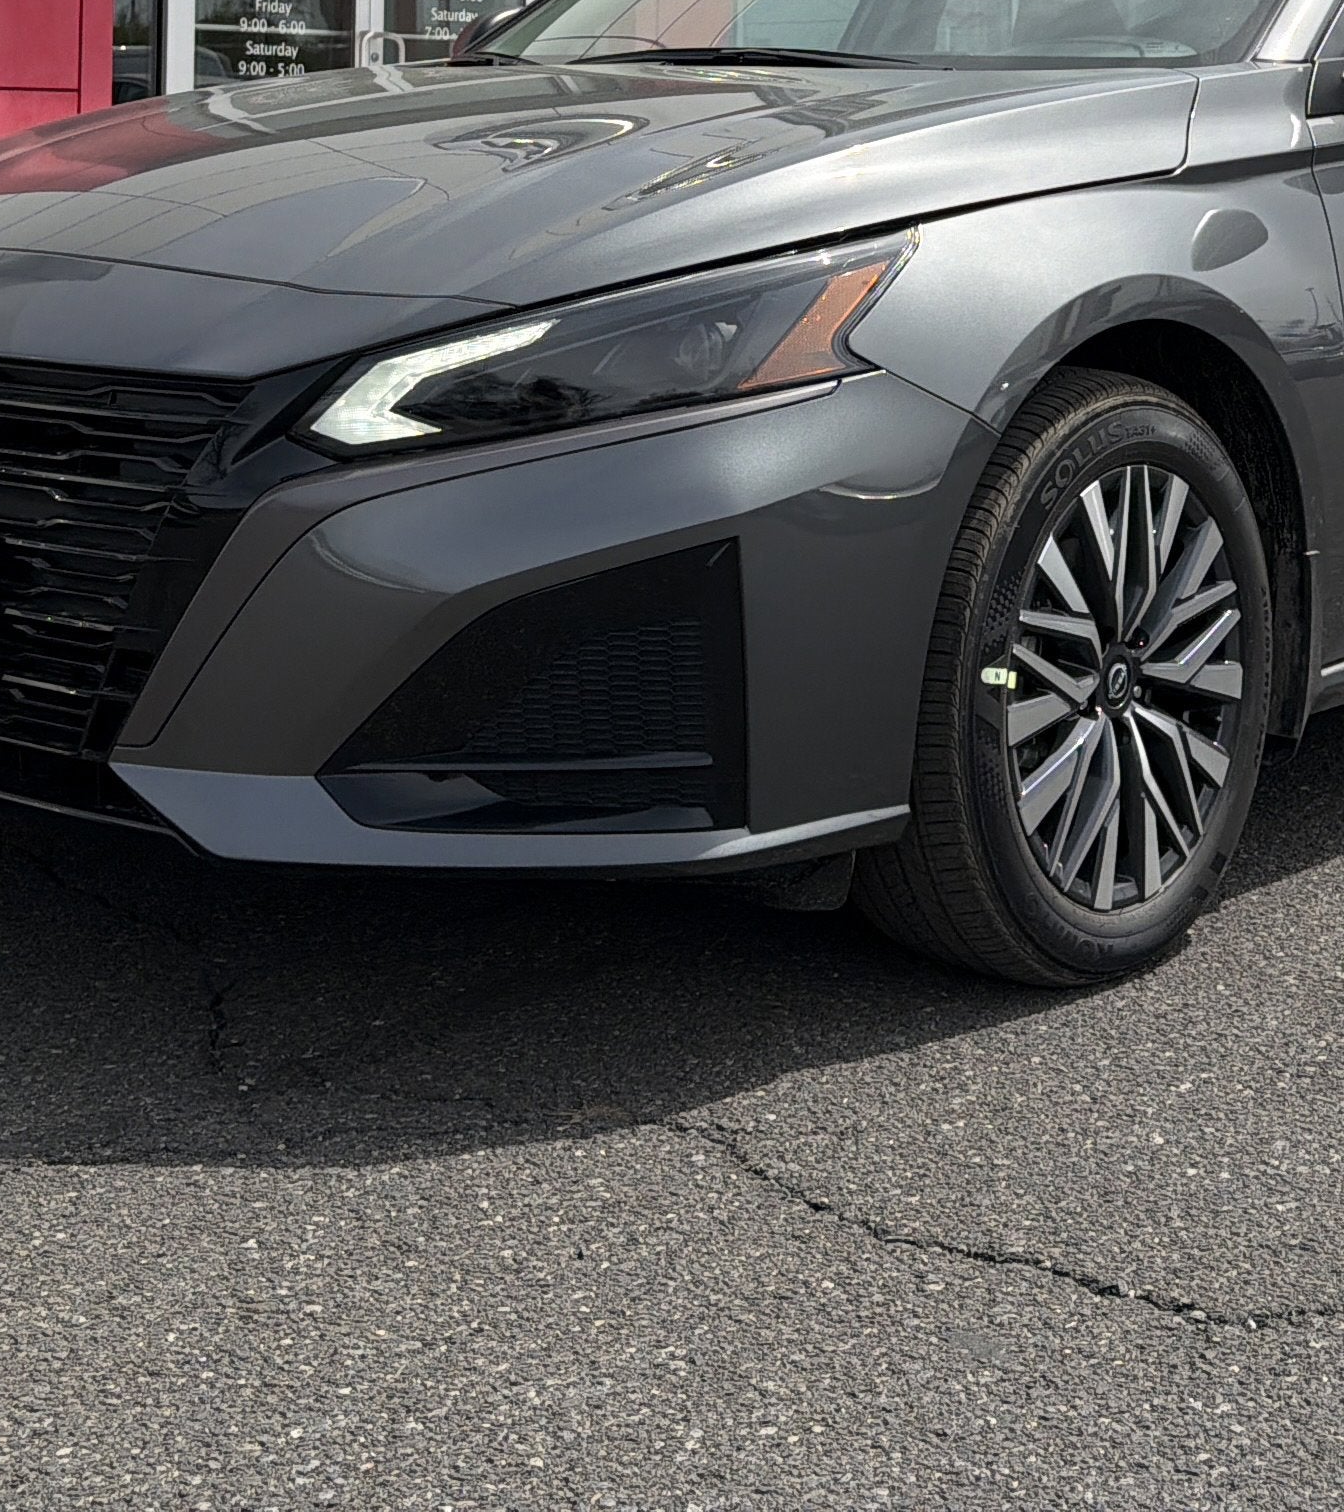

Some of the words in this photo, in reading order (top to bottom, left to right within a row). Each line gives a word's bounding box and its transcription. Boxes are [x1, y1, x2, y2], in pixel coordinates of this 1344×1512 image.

[431, 7, 478, 22] Saturday
[239, 17, 267, 33] 9:00
[278, 19, 306, 35] 6:00
[424, 26, 450, 40] 7:00
[245, 40, 299, 60] Saturday
[238, 60, 266, 76] 9:00
[277, 62, 305, 77] 5:00
[1040, 420, 1124, 511] SOLUS
